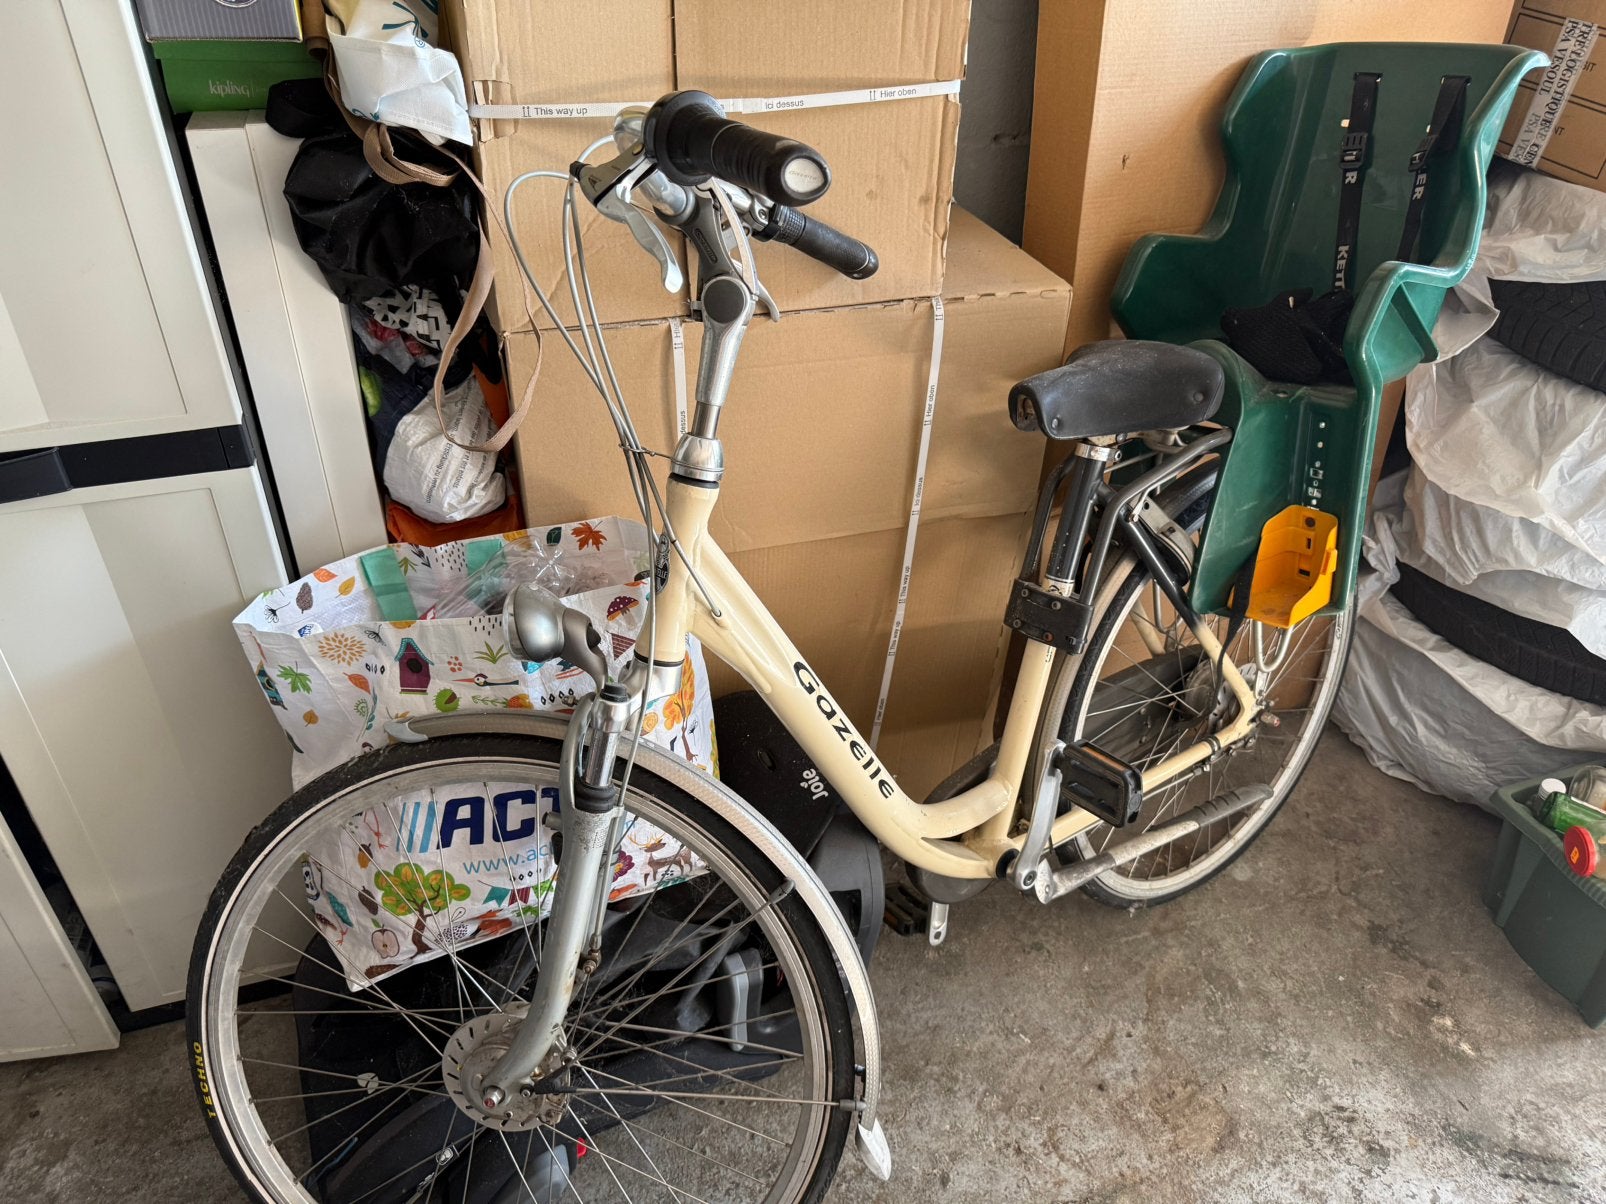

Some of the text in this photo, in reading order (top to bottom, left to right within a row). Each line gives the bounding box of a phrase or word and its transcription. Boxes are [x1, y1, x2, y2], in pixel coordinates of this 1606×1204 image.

[1560, 20, 1579, 43] PSA
[1539, 48, 1568, 96] VESOUL
[208, 79, 250, 98] kipling
[765, 88, 917, 109] Ici dessus Hier oben
[534, 107, 588, 116] This way up
[793, 661, 895, 799] Gazelle
[802, 768, 829, 801] Joie
[193, 1041, 217, 1118] TECHNO
